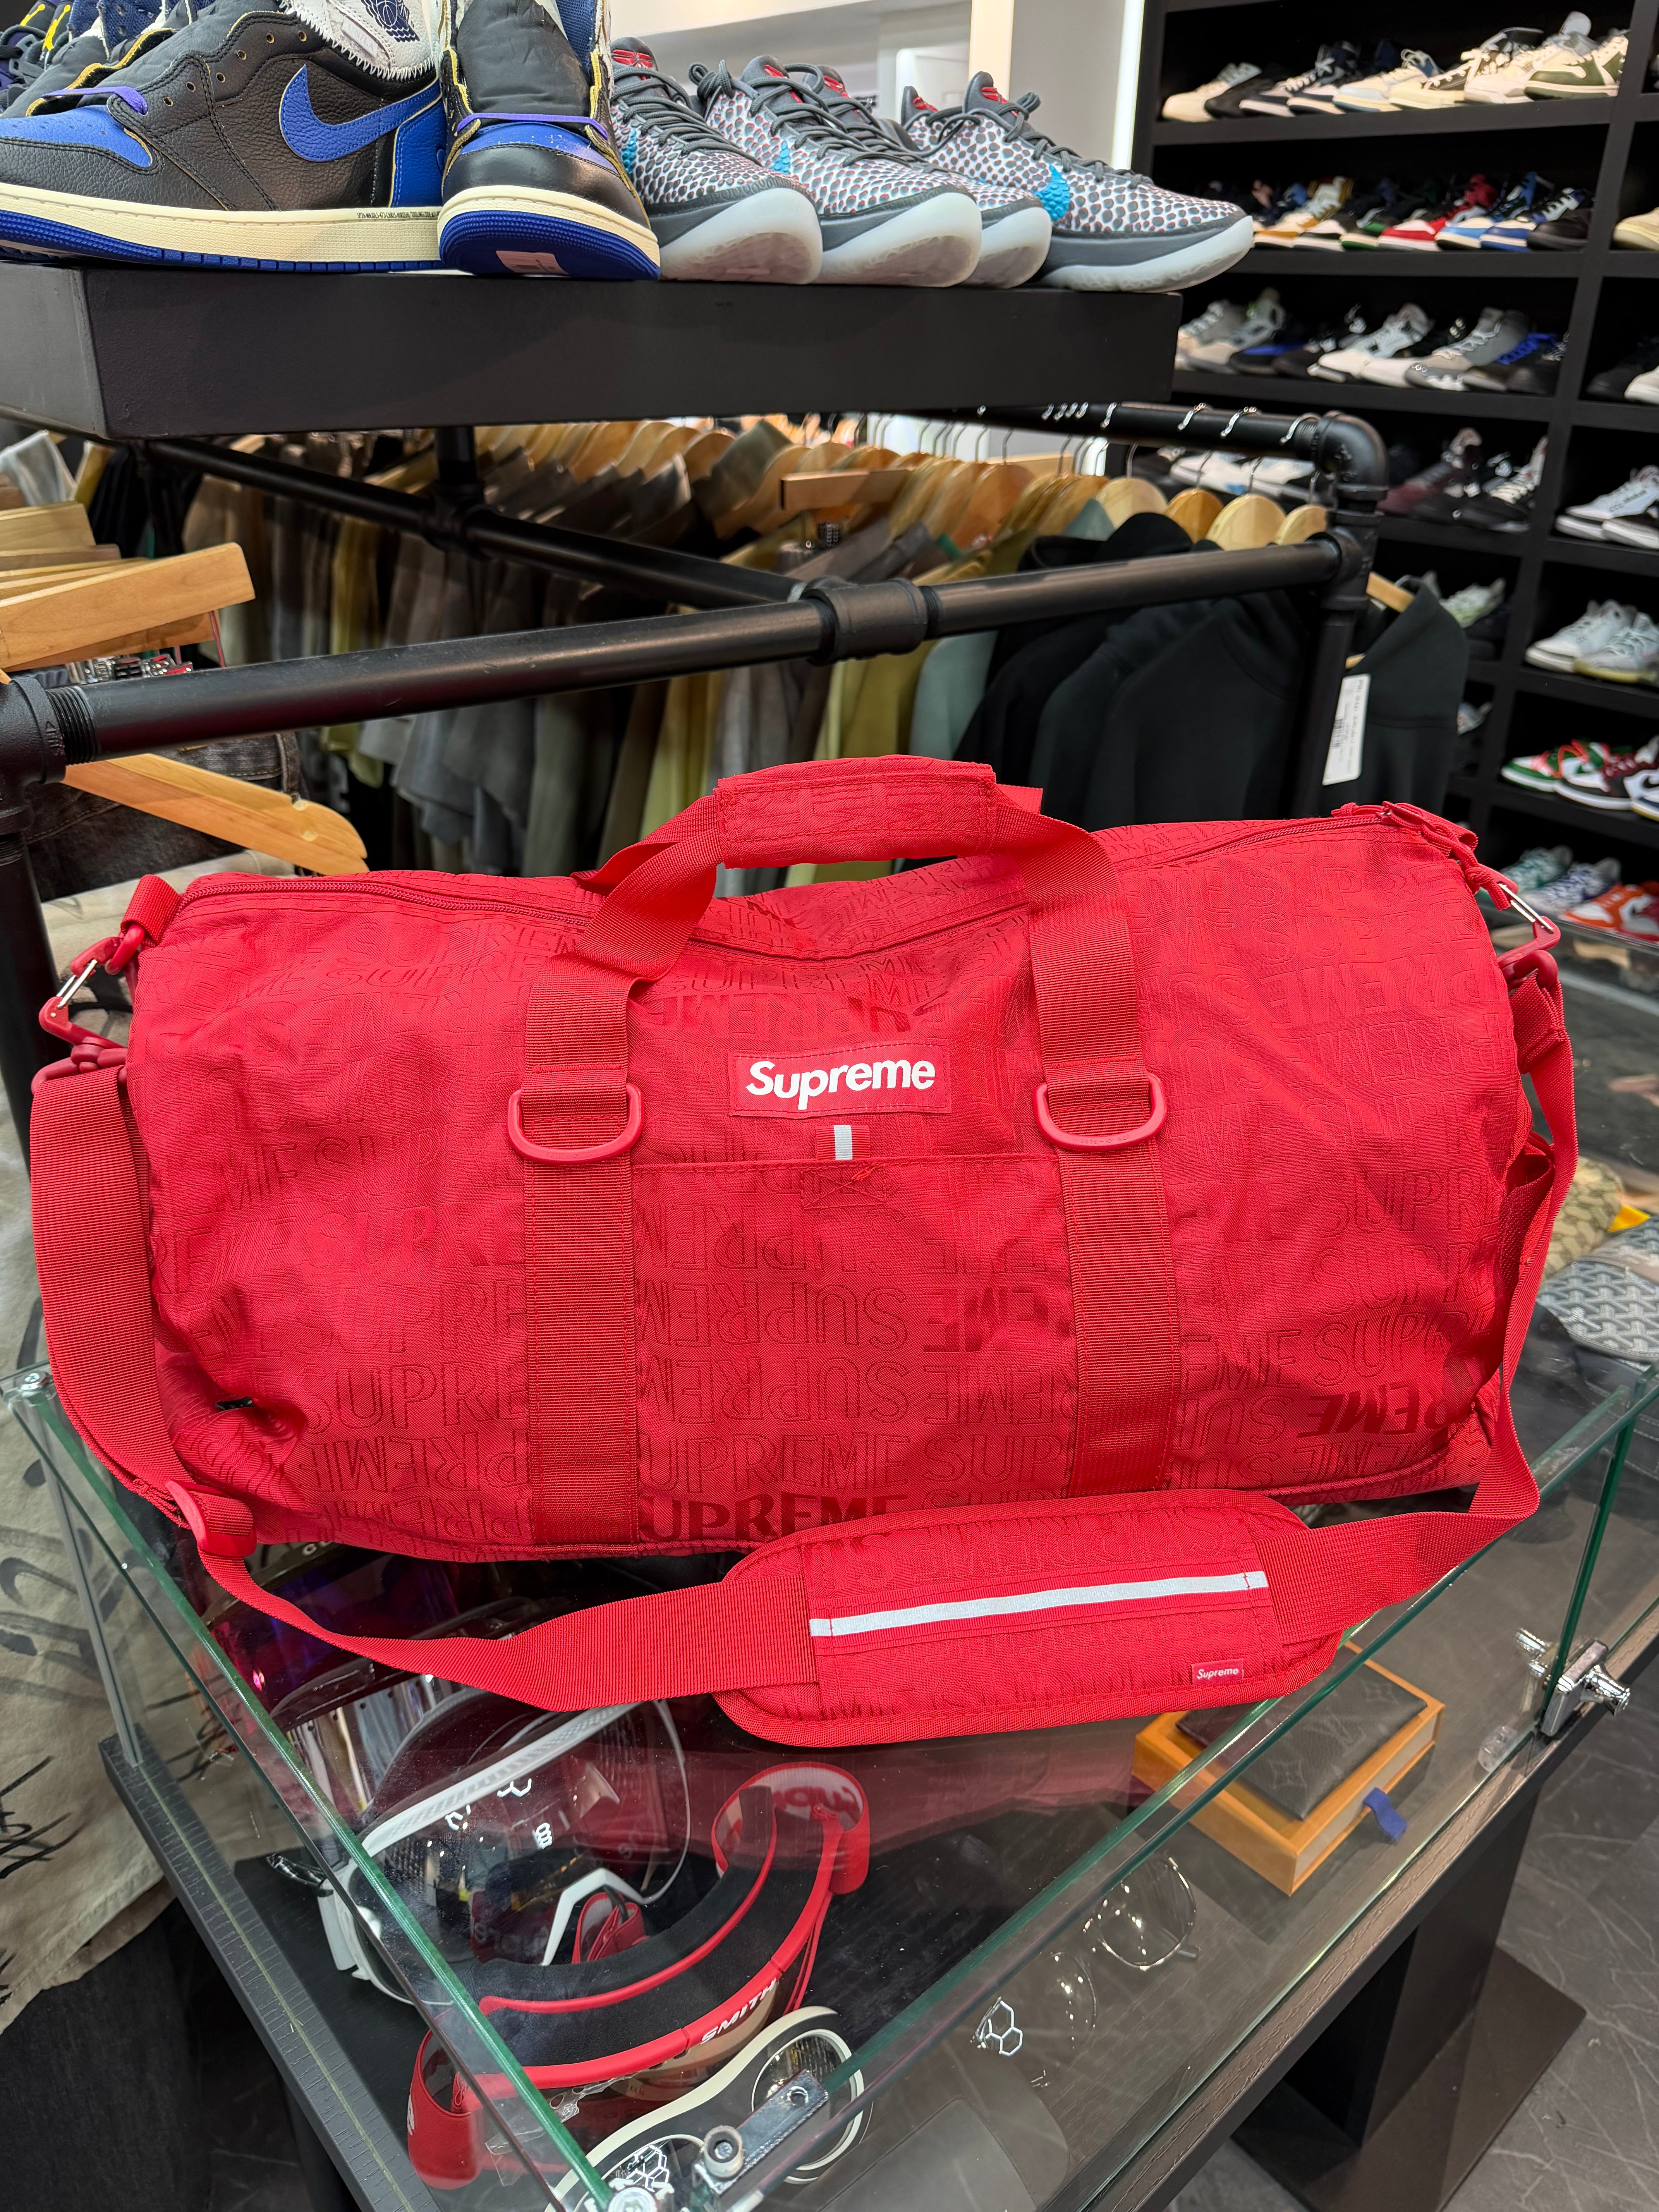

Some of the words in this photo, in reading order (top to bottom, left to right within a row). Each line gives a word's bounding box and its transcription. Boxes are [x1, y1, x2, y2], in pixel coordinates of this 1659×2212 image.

[745, 1060, 935, 1110] Supreme
[294, 1278, 527, 1355] SUPRE
[638, 1280, 908, 1351] SUPREM
[296, 1359, 528, 1435] SUPRE
[639, 1355, 910, 1424] SUPREM
[639, 1432, 911, 1493] UPREME
[1197, 1668, 1239, 1680] Supreme
[700, 1977, 776, 2045] SMITH
